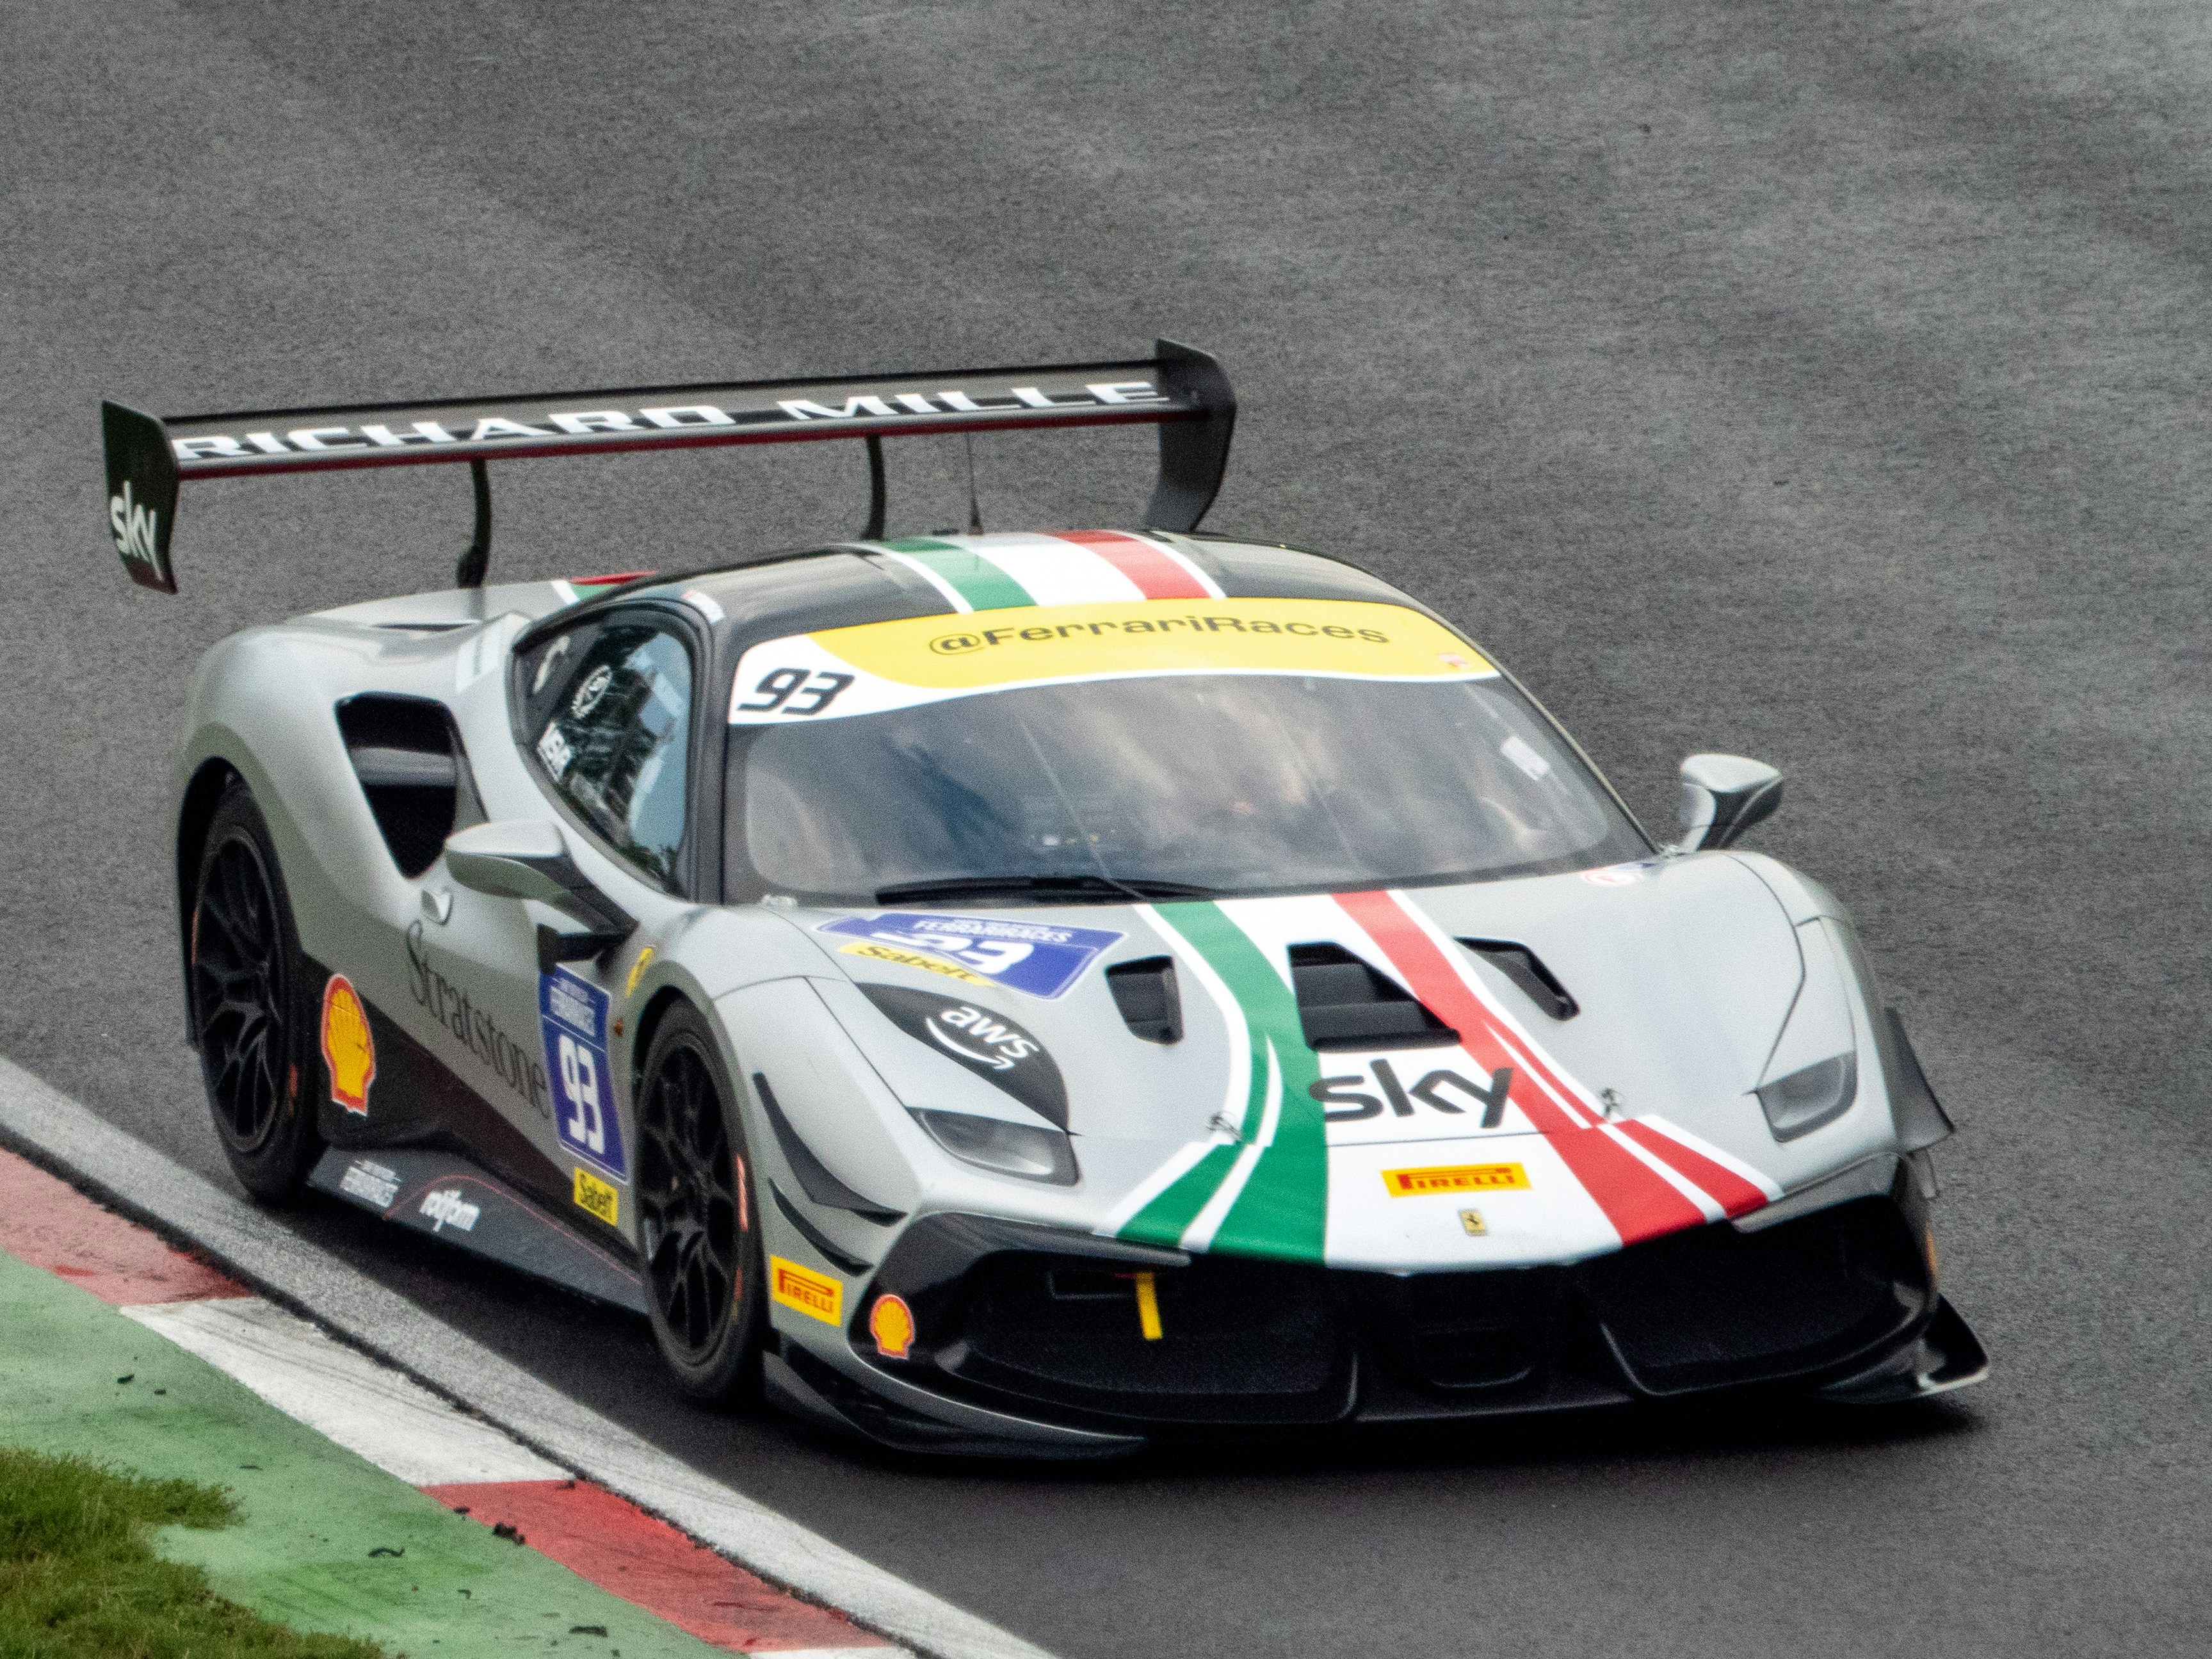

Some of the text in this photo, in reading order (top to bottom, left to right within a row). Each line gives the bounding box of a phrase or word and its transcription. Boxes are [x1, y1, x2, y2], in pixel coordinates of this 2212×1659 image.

[170, 382, 1170, 460] RICHARD MILLE
[110, 481, 166, 581] sky
[929, 615, 1391, 655] @FerrariRaces
[737, 667, 855, 716] 93
[406, 919, 551, 1119] Stratstone
[941, 1007, 1040, 1060] aws
[558, 1033, 605, 1154] 93
[1308, 1058, 1514, 1129] sky
[1396, 1167, 1516, 1190] PIRELLI
[777, 1268, 834, 1315] PIRELLI
